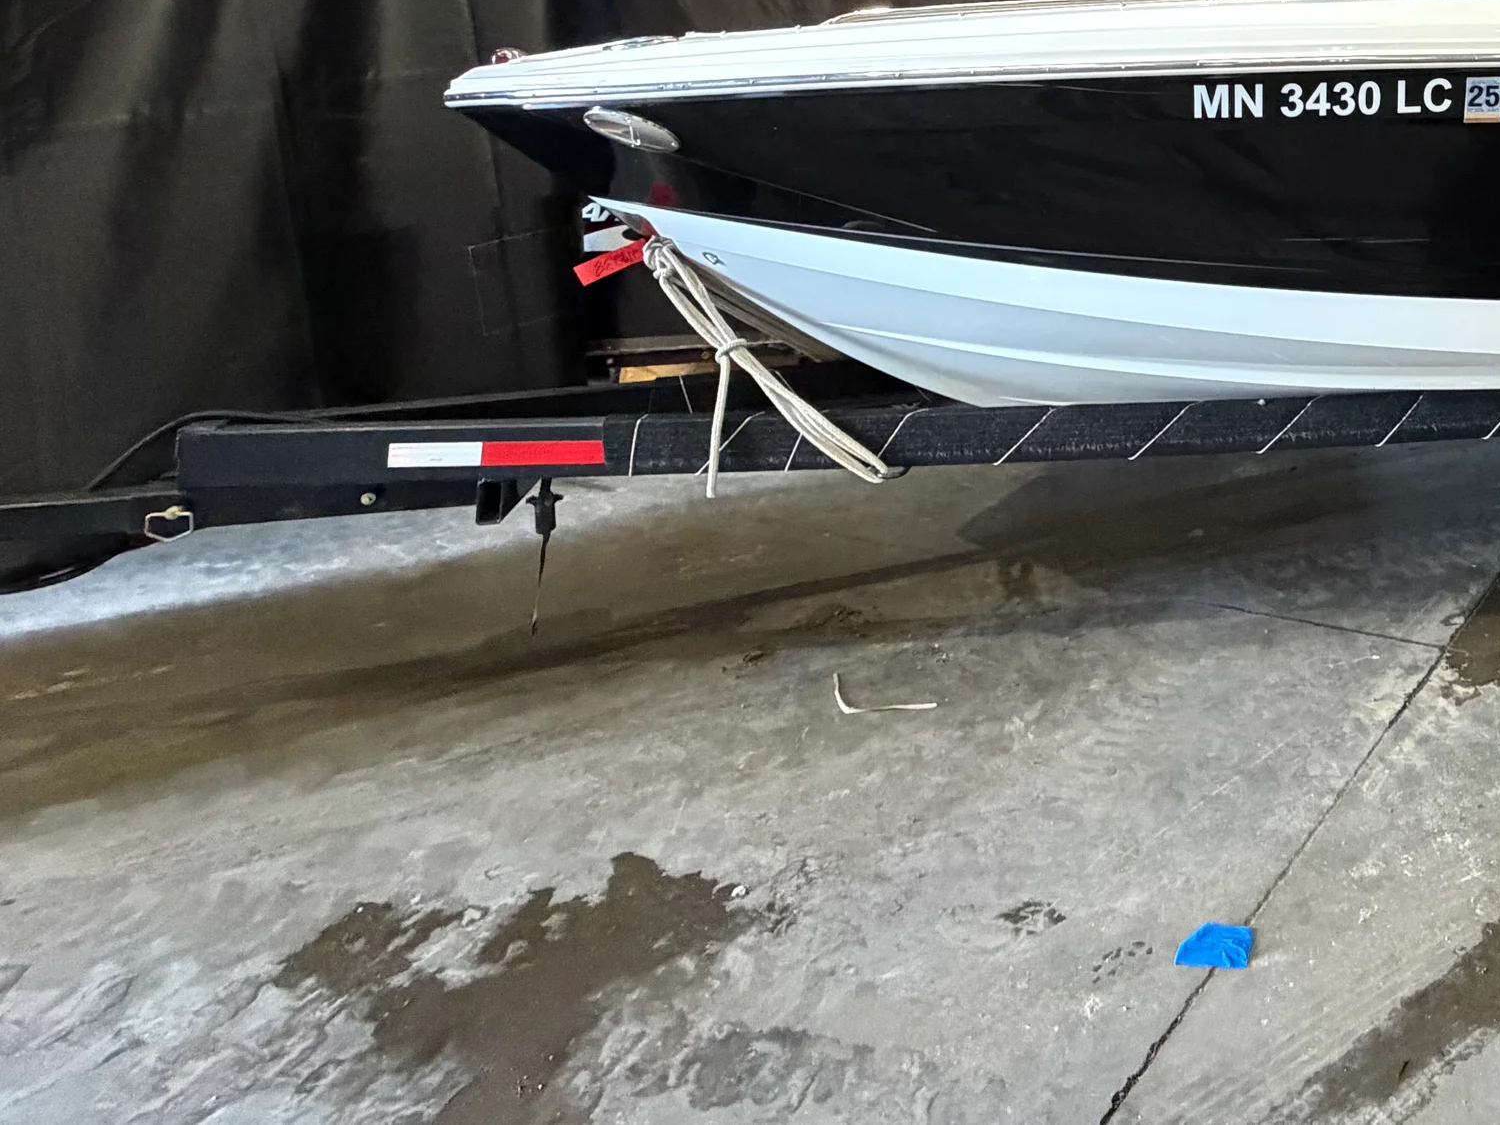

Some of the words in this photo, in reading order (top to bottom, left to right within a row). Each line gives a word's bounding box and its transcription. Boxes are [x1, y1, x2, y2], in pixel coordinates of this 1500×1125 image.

[1193, 84, 1263, 118] MN
[1280, 80, 1381, 117] 3430
[1397, 78, 1452, 114] LC
[1468, 85, 1500, 107] 25
